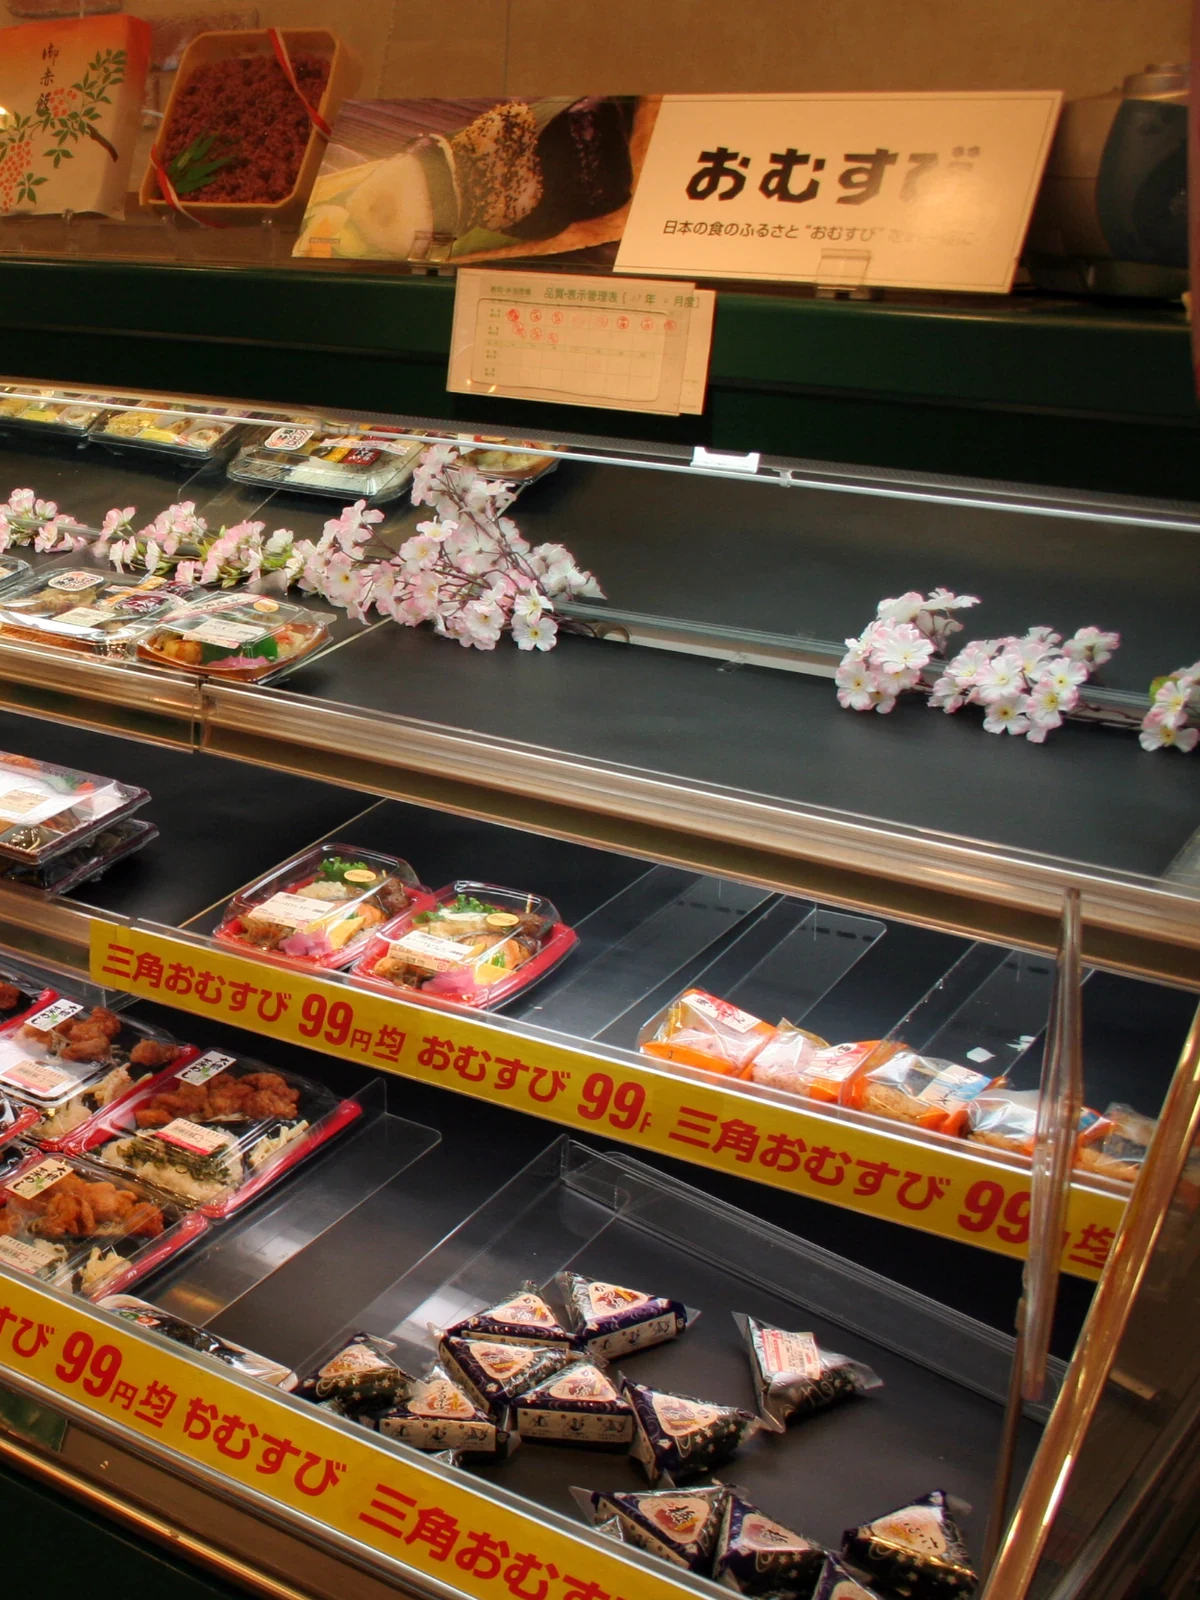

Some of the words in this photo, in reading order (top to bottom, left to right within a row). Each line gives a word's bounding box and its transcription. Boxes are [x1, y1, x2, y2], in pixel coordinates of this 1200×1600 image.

[36, 42, 60, 115] 御赤飯
[102, 943, 293, 1023] 三角おむすび
[417, 1036, 571, 1103] おむすび
[668, 1105, 952, 1212] 三角おむすび
[183, 1396, 347, 1497] おむすび
